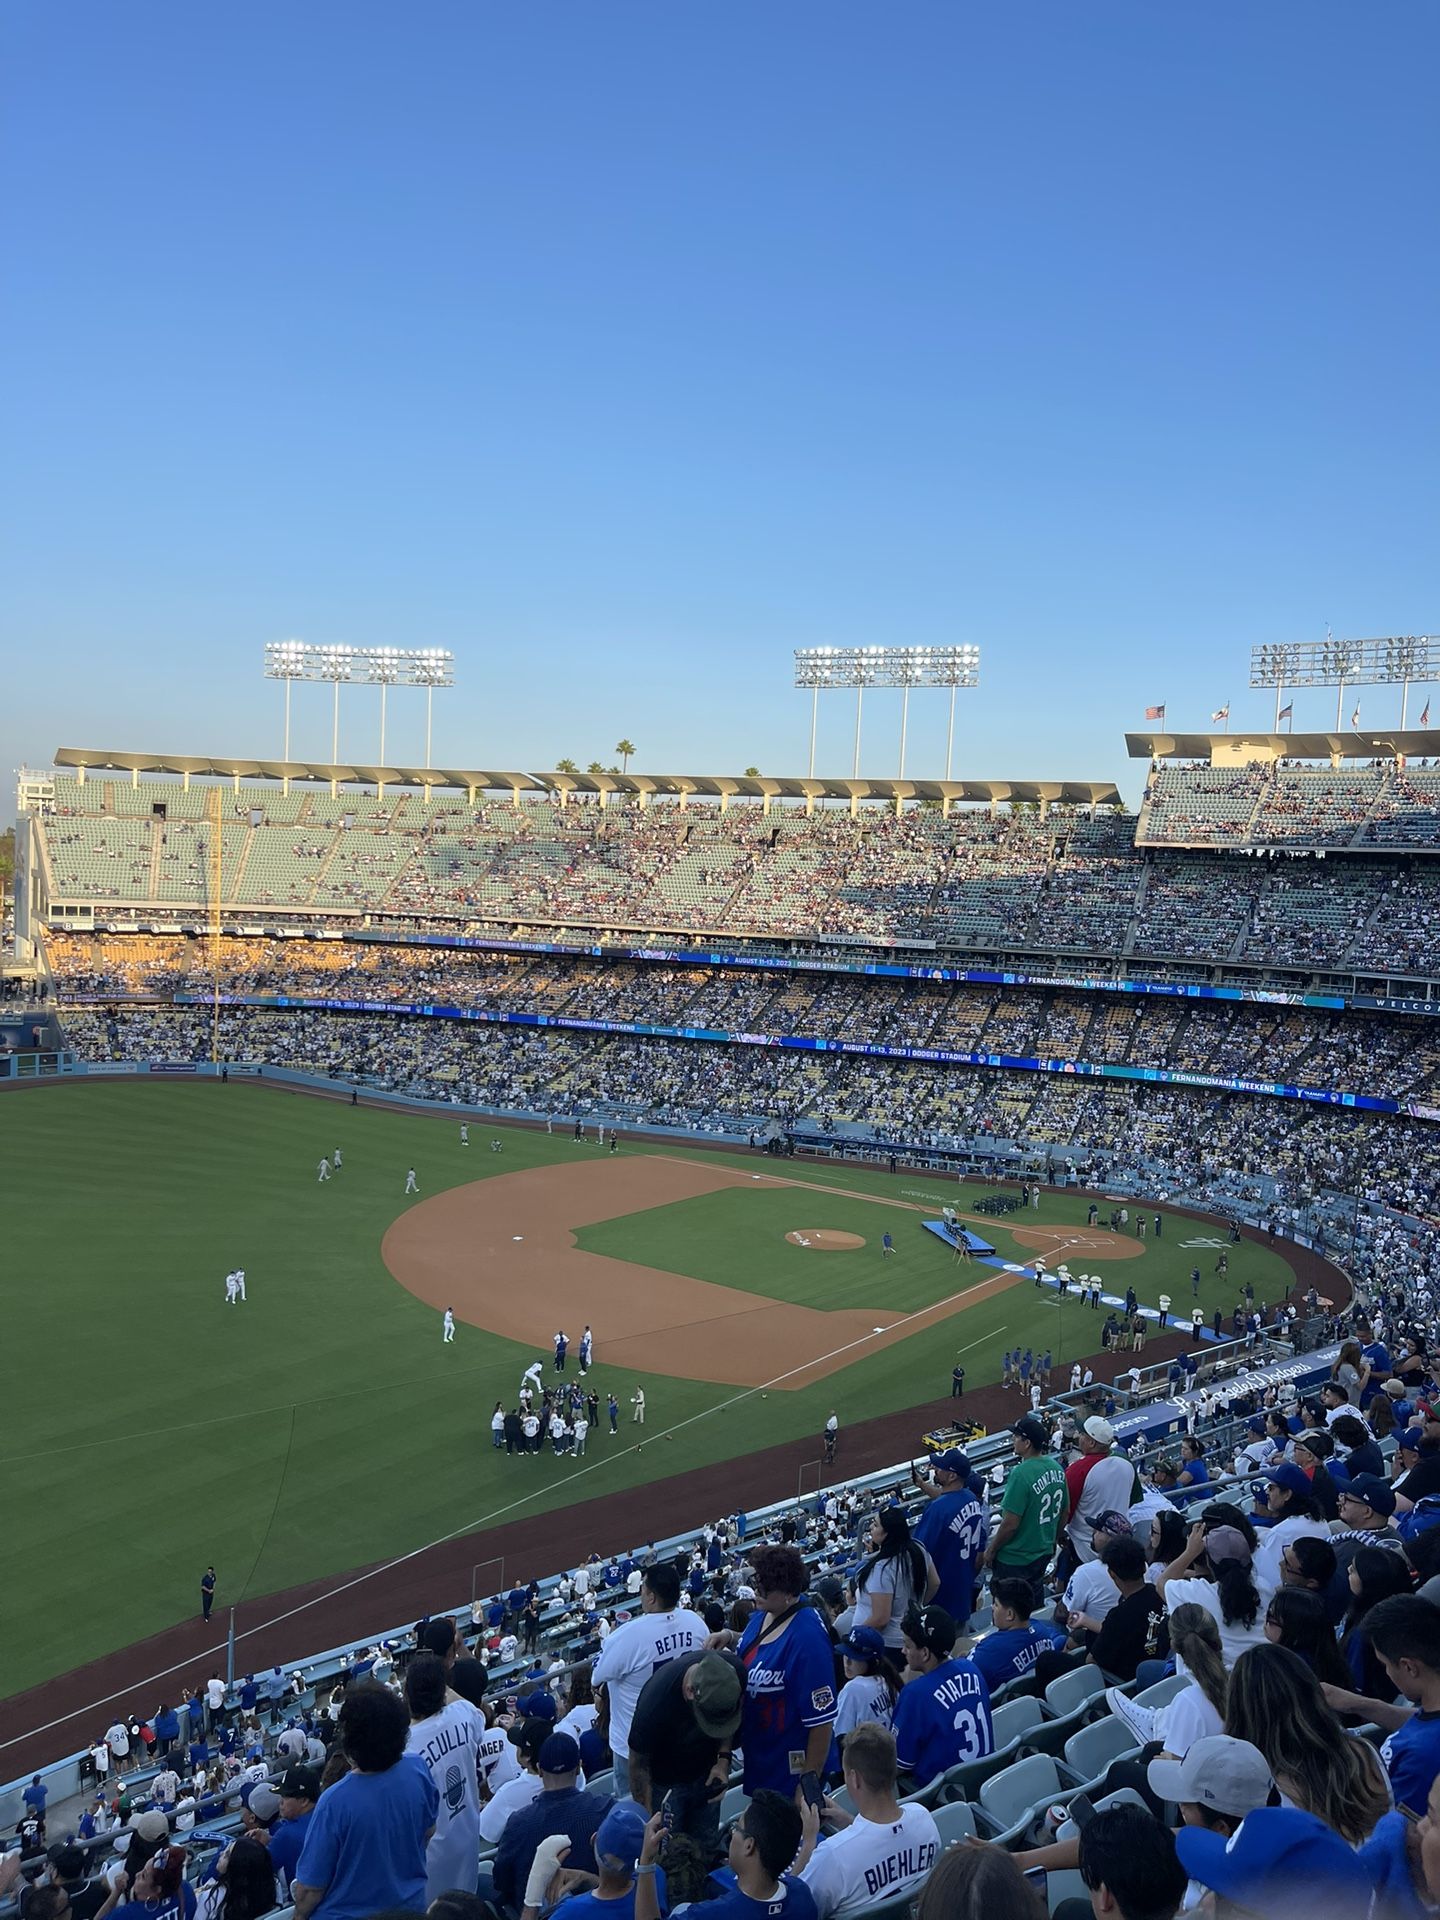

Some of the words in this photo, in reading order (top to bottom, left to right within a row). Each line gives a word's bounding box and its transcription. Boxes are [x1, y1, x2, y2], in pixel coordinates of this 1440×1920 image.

[475, 939, 520, 949] FERNANDOMANIA
[520, 943, 547, 951] WEEKEND
[825, 936, 843, 944] BANK
[853, 938, 883, 946] AMERICA
[734, 957, 758, 965] AUGUST
[759, 958, 775, 967] 11-13,
[776, 959, 792, 968] 2023
[797, 961, 821, 970] DODGER
[822, 962, 850, 971] STADIUM
[1028, 976, 1088, 988] FERNANDOMANIA
[363, 1002, 386, 1010] DODGER
[386, 1004, 411, 1012] STADIUM
[1376, 1000, 1440, 1012] WELCO
[557, 1018, 606, 1029] FERNANDOMANIA
[607, 1023, 635, 1032] WEEKEND
[842, 1043, 869, 1052] AUGUST
[870, 1046, 886, 1055] 11-13,
[888, 1047, 907, 1056] 2023
[912, 1049, 940, 1059] DODGER
[940, 1052, 972, 1062] STADIUM
[1171, 1073, 1237, 1089] FERNANDOMANIA
[1238, 1080, 1275, 1093] WEEKEND
[1245, 1362, 1312, 1391] Dodgers
[1039, 1488, 1064, 1524] 23
[959, 1518, 982, 1560] 34
[655, 1631, 693, 1656] BETTS
[746, 1661, 786, 1698] dgers
[933, 1672, 982, 1710] PIAZZA
[760, 1698, 785, 1733] 31
[114, 1733, 125, 1743] 34
[953, 1701, 990, 1762] 31
[23, 1825, 38, 1837] 42
[863, 1843, 935, 1896] BUEHLER
